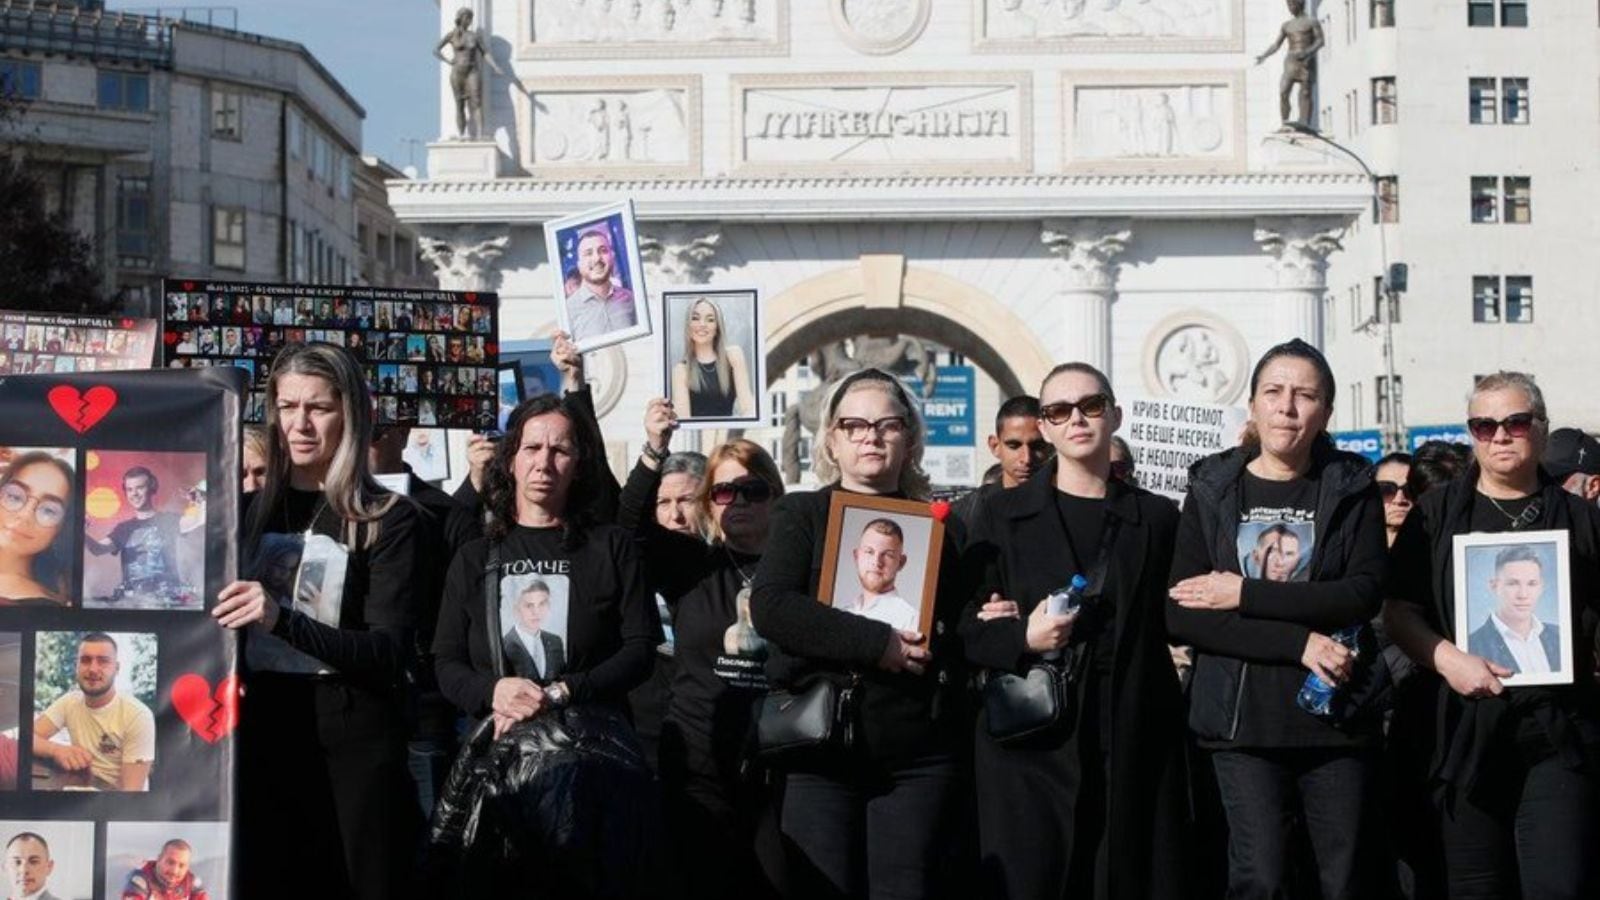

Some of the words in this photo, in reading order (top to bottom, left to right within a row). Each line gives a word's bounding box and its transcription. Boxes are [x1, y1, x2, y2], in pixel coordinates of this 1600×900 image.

[757, 110, 1010, 139] МАКЕДОНИЈА
[924, 403, 967, 417] RENT
[1132, 401, 1161, 419] КРИВ
[1162, 404, 1169, 420] Е
[1171, 404, 1226, 428] СИСТЕМОТ,
[1130, 423, 1144, 440] НЕ
[1146, 424, 1175, 444] БЕШЕ
[1336, 438, 1378, 452] tec
[1146, 447, 1202, 469] НЕОДГОВО
[1150, 472, 1162, 490] ЗА
[1164, 474, 1188, 493] НАШ
[502, 558, 570, 575] ТОМЧЕ
